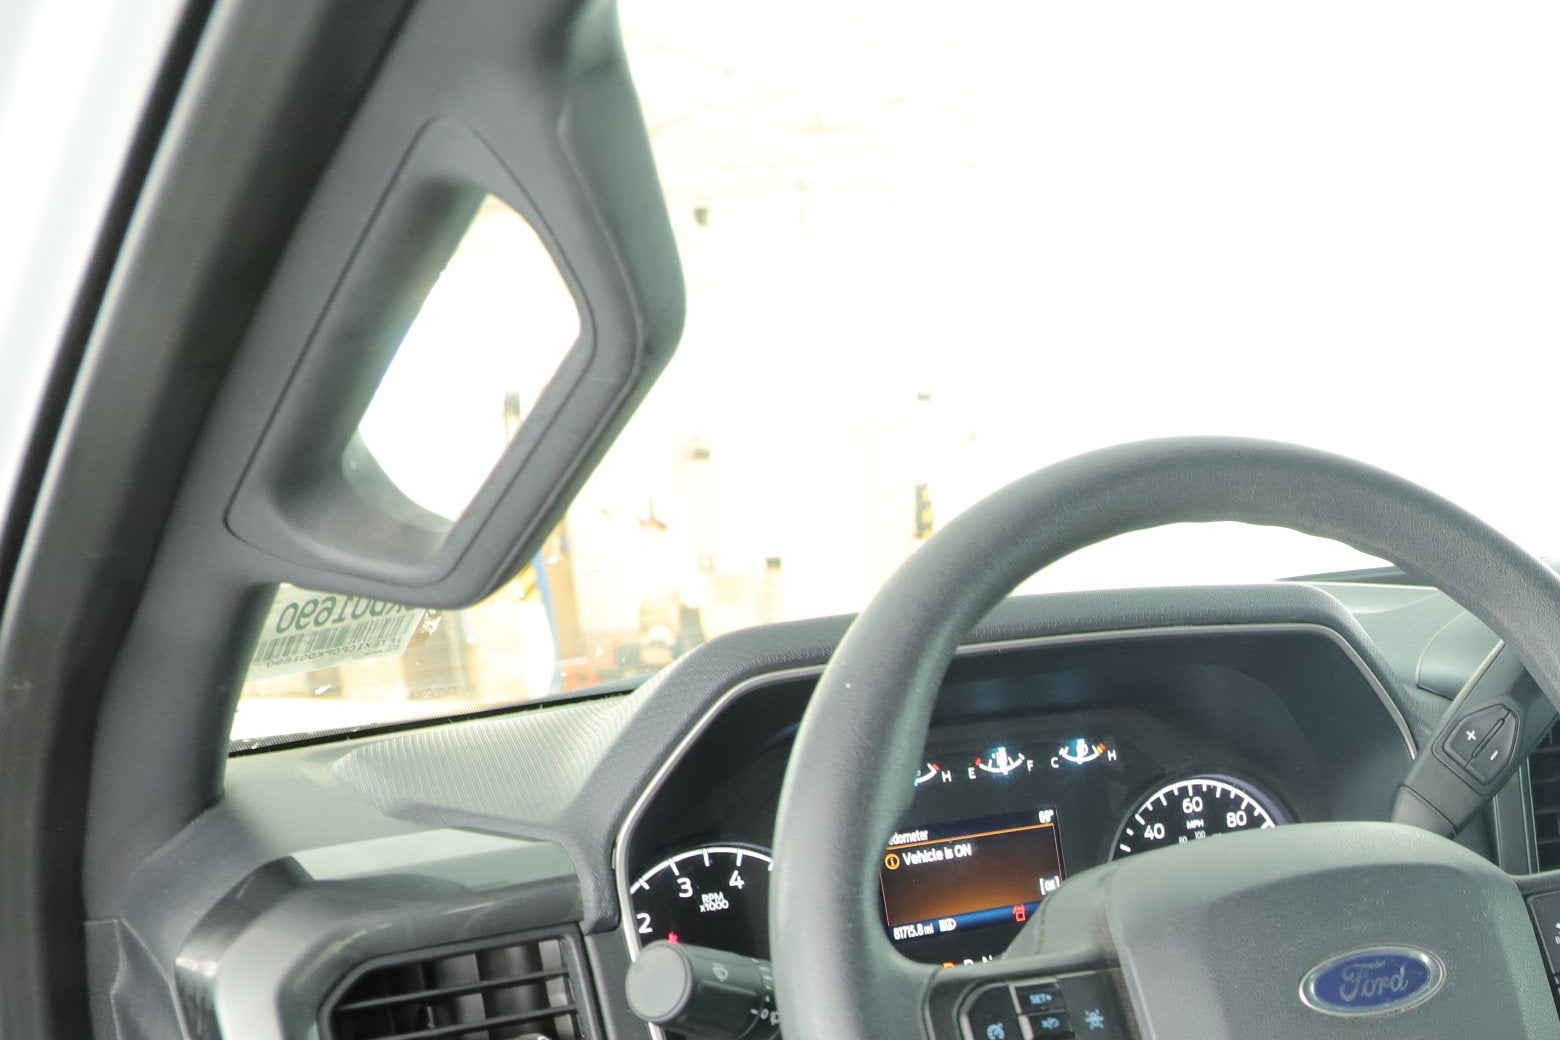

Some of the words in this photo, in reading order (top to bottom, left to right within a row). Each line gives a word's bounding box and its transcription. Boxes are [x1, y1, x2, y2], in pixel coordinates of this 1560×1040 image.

[1050, 757, 1060, 769] C
[1107, 749, 1117, 761] H
[941, 769, 952, 782] H
[967, 767, 976, 780] E
[1026, 759, 1034, 772] F
[1182, 796, 1203, 814] 60
[1186, 818, 1204, 829] MPH
[1226, 811, 1247, 828] 80
[1144, 823, 1165, 840] 40
[902, 848, 943, 866] Vehicle
[943, 846, 954, 860] is
[954, 843, 972, 858] ON
[676, 877, 693, 898] 3
[728, 870, 745, 890] 4
[701, 891, 724, 903] RPM
[636, 912, 653, 934] 2
[1339, 960, 1409, 1002] Ford
